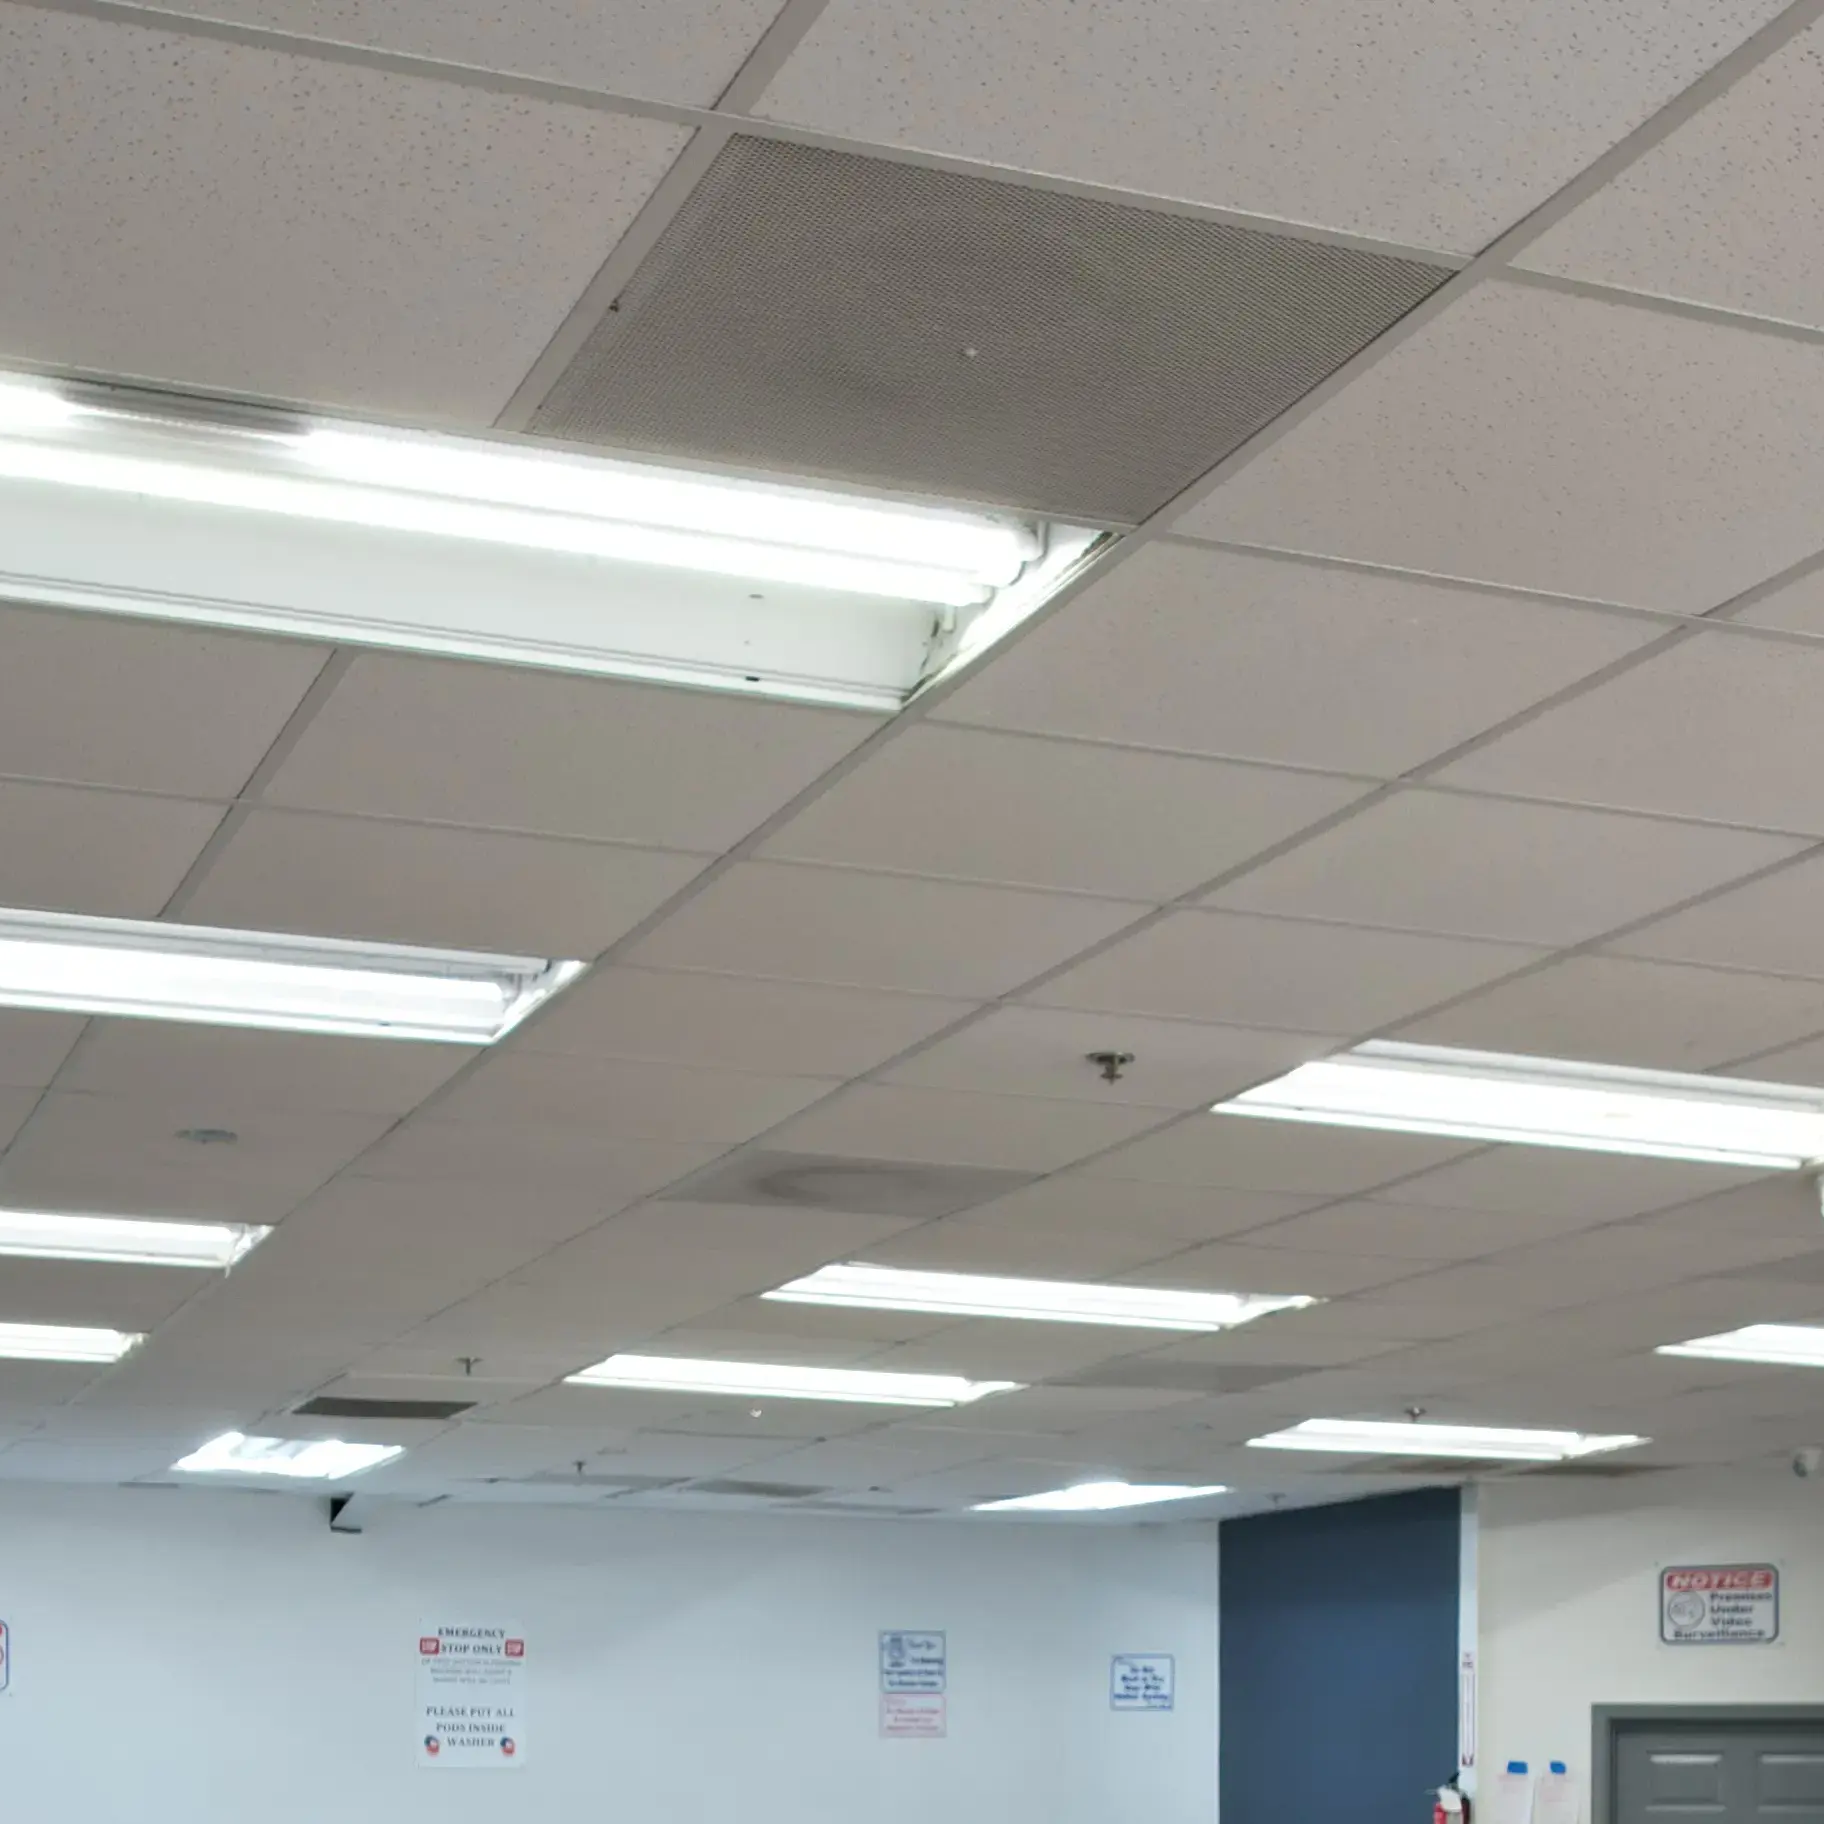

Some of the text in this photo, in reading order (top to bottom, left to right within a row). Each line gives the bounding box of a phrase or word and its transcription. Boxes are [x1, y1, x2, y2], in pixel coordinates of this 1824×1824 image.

[1672, 1571, 1766, 1589] NOTICE
[1710, 1605, 1754, 1614] Under
[438, 1627, 506, 1639] EMERGENCY
[441, 1643, 502, 1655] STOP ONLY
[426, 1705, 515, 1718] PLEASE PUT ALL
[436, 1722, 506, 1734] PODS INSIDE
[447, 1736, 495, 1748] WASHER
